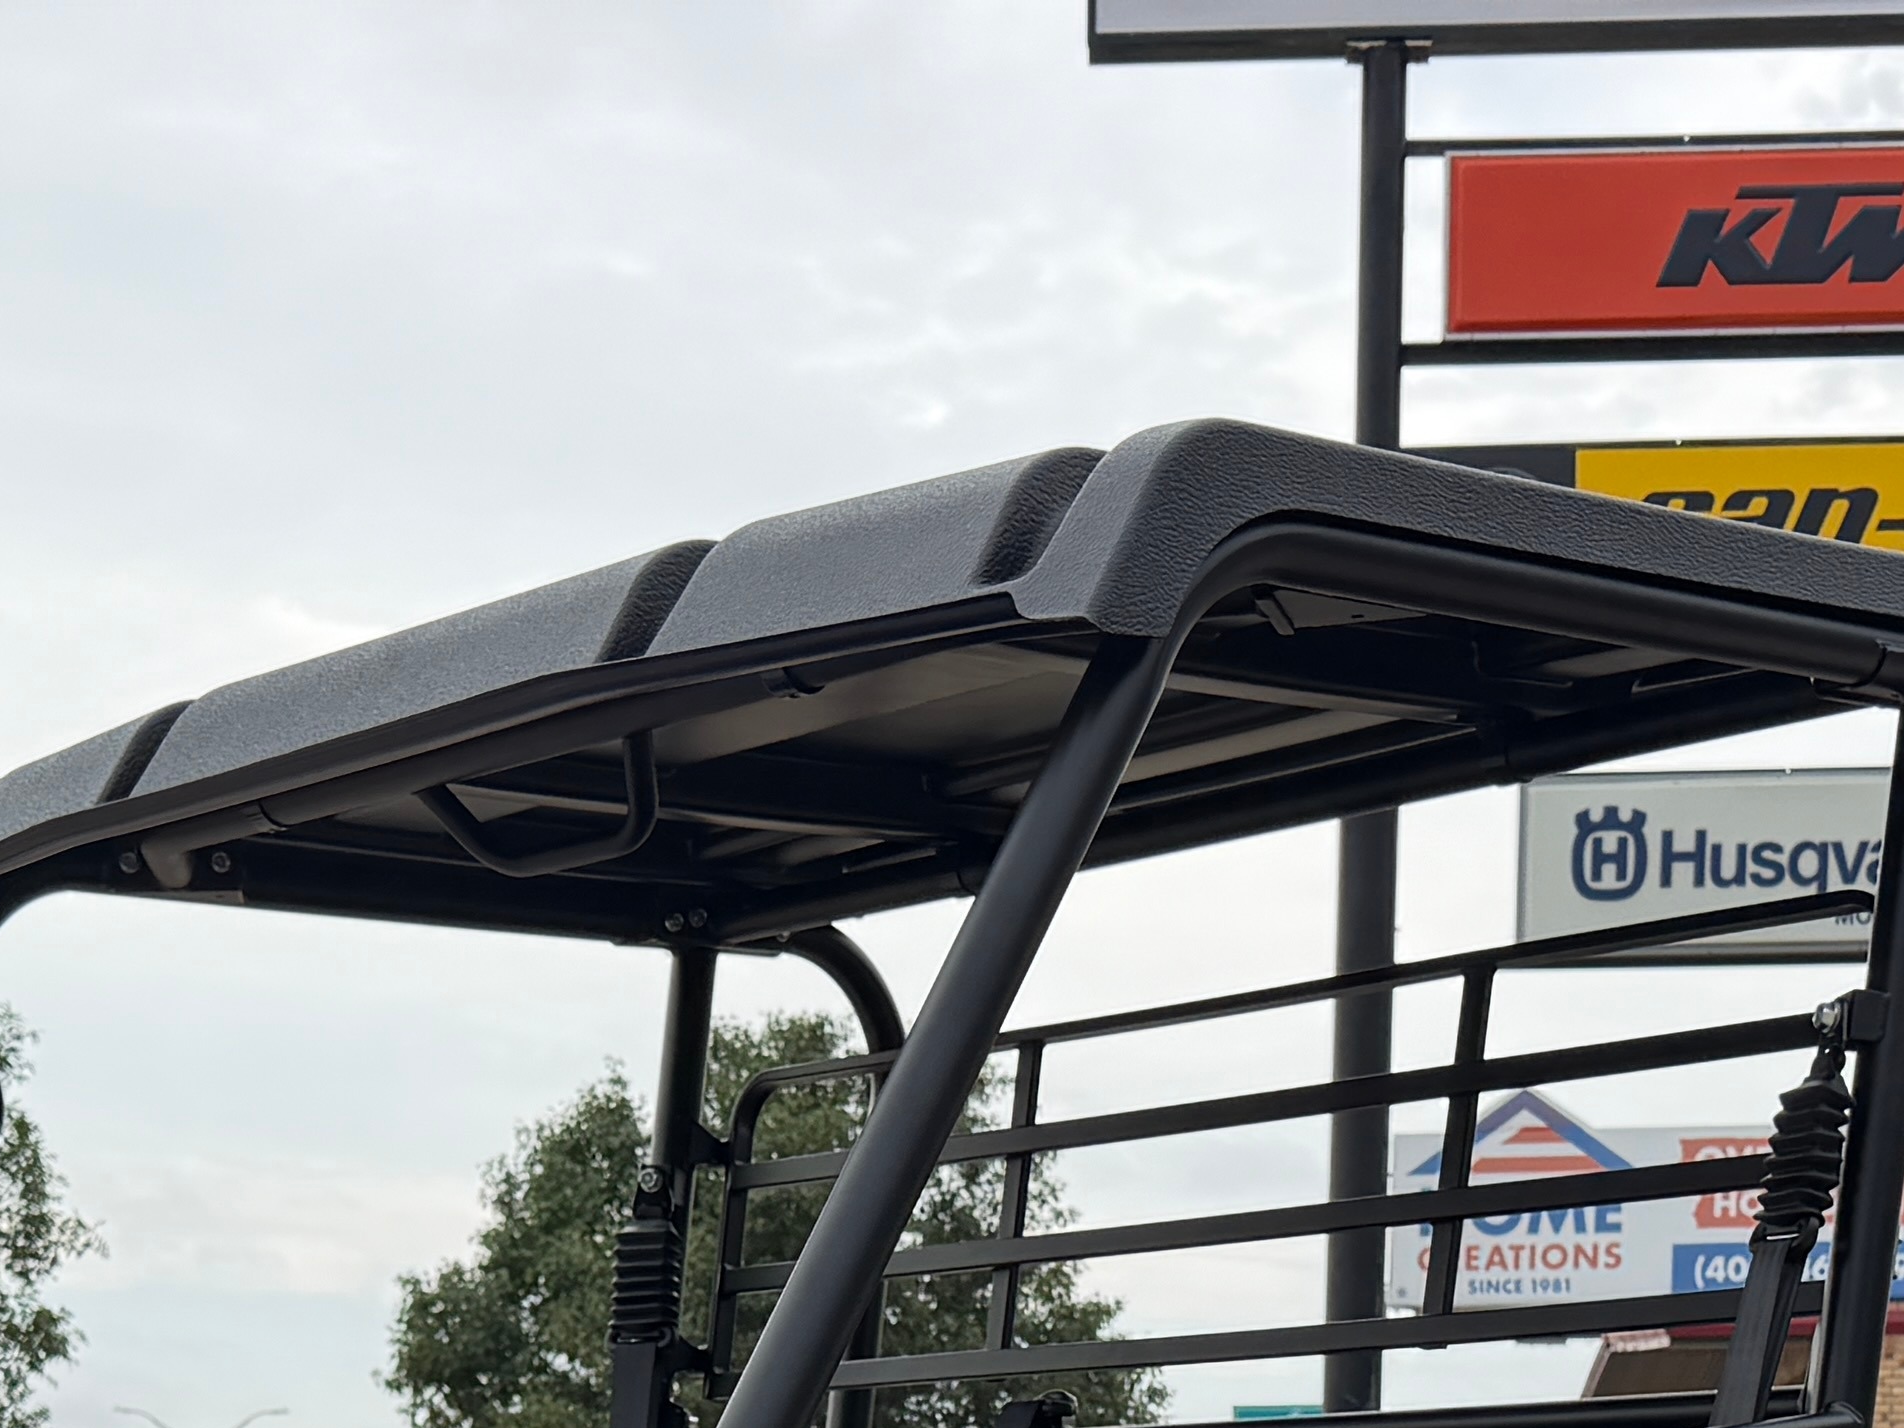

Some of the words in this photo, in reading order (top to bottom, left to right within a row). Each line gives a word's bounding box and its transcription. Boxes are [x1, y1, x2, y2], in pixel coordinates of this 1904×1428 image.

[1419, 1187, 1623, 1236] OME
[1416, 1242, 1623, 1272] CEATIONS
[1467, 1278, 1522, 1295] SINCE
[1531, 1277, 1571, 1294] 1981
